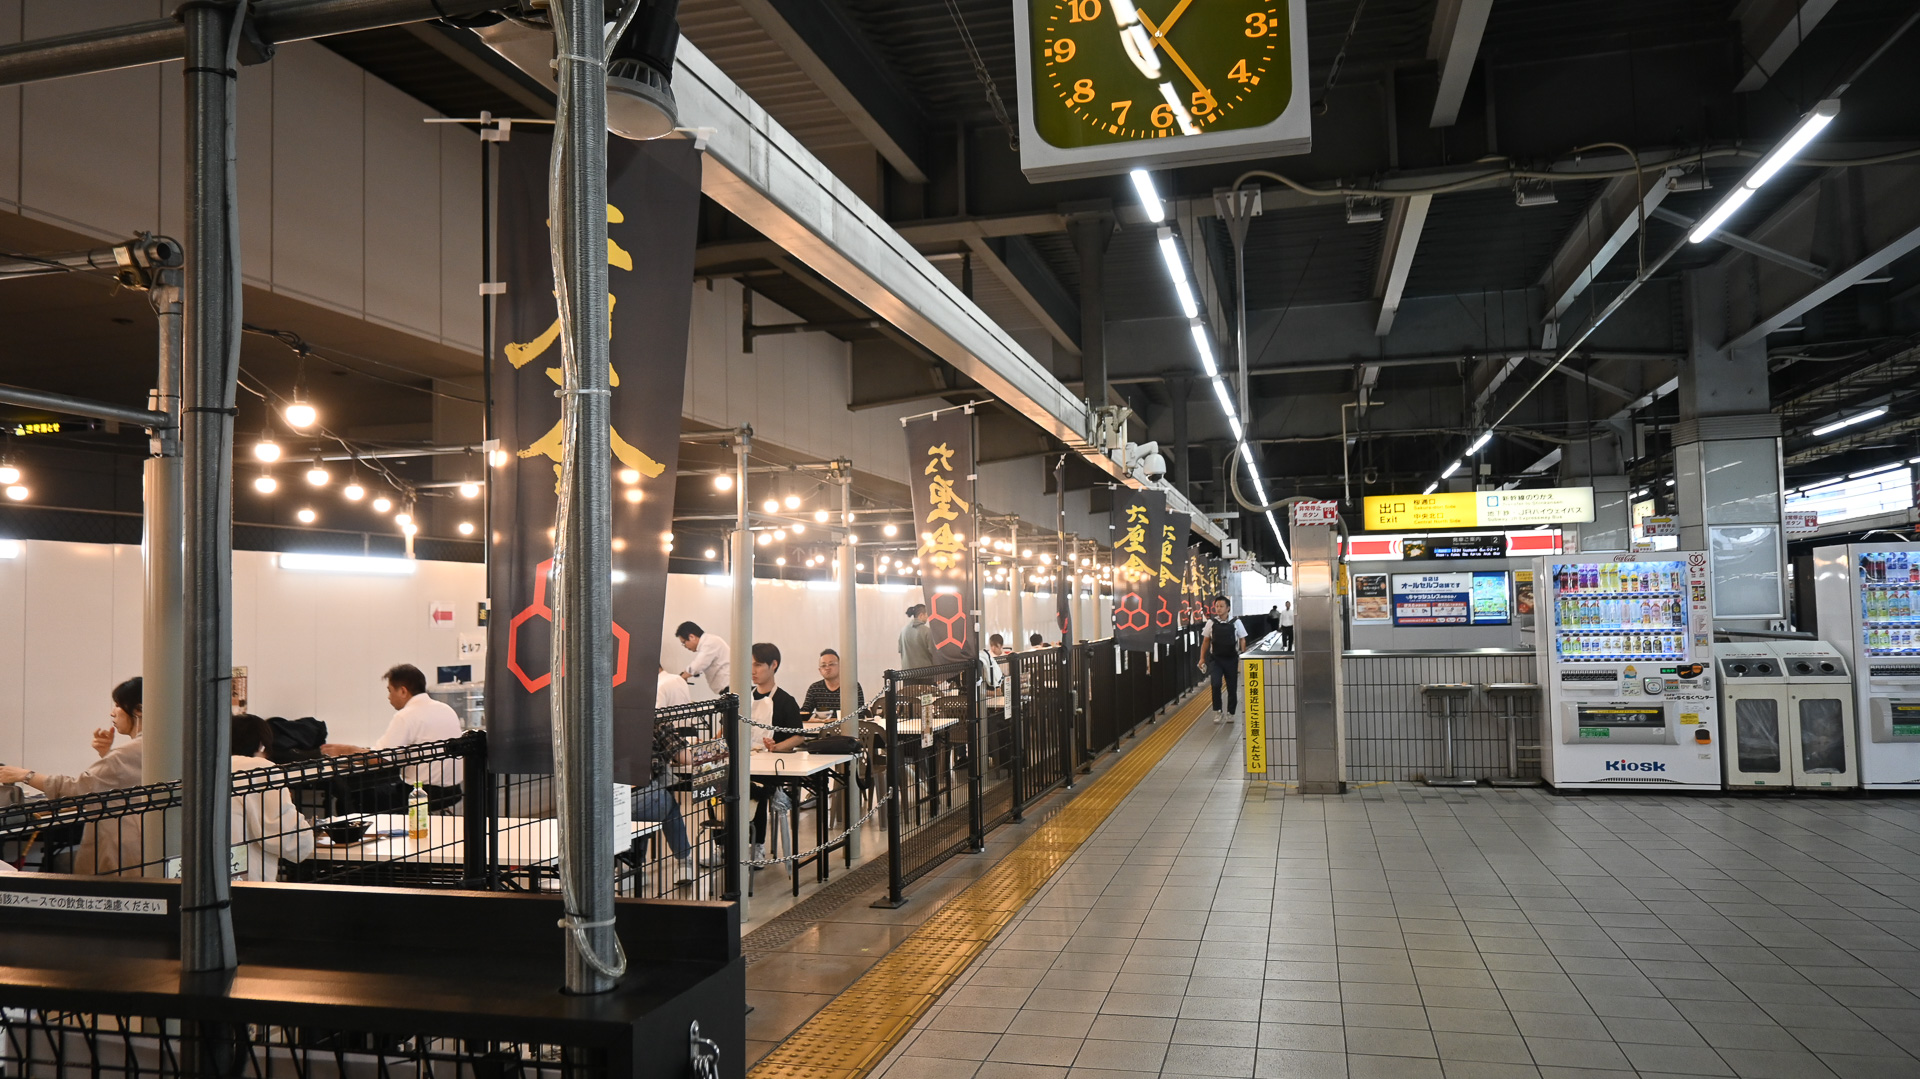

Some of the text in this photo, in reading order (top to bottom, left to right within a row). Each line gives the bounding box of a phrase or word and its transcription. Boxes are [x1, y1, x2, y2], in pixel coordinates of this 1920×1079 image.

[1068, 0, 1102, 23] 10
[1245, 12, 1268, 38] 3
[1053, 38, 1076, 63] 9
[1227, 59, 1252, 83] 4
[1072, 79, 1095, 103] 8
[1191, 89, 1214, 116] 5
[1111, 100, 1132, 125] 7
[1150, 104, 1174, 128] 6
[1380, 502, 1406, 514] 出口
[1380, 516, 1398, 524] Exit
[1226, 543, 1232, 554] 1
[1249, 663, 1261, 769] 列車の接近にご注意ください
[1606, 760, 1666, 772] Kiosk
